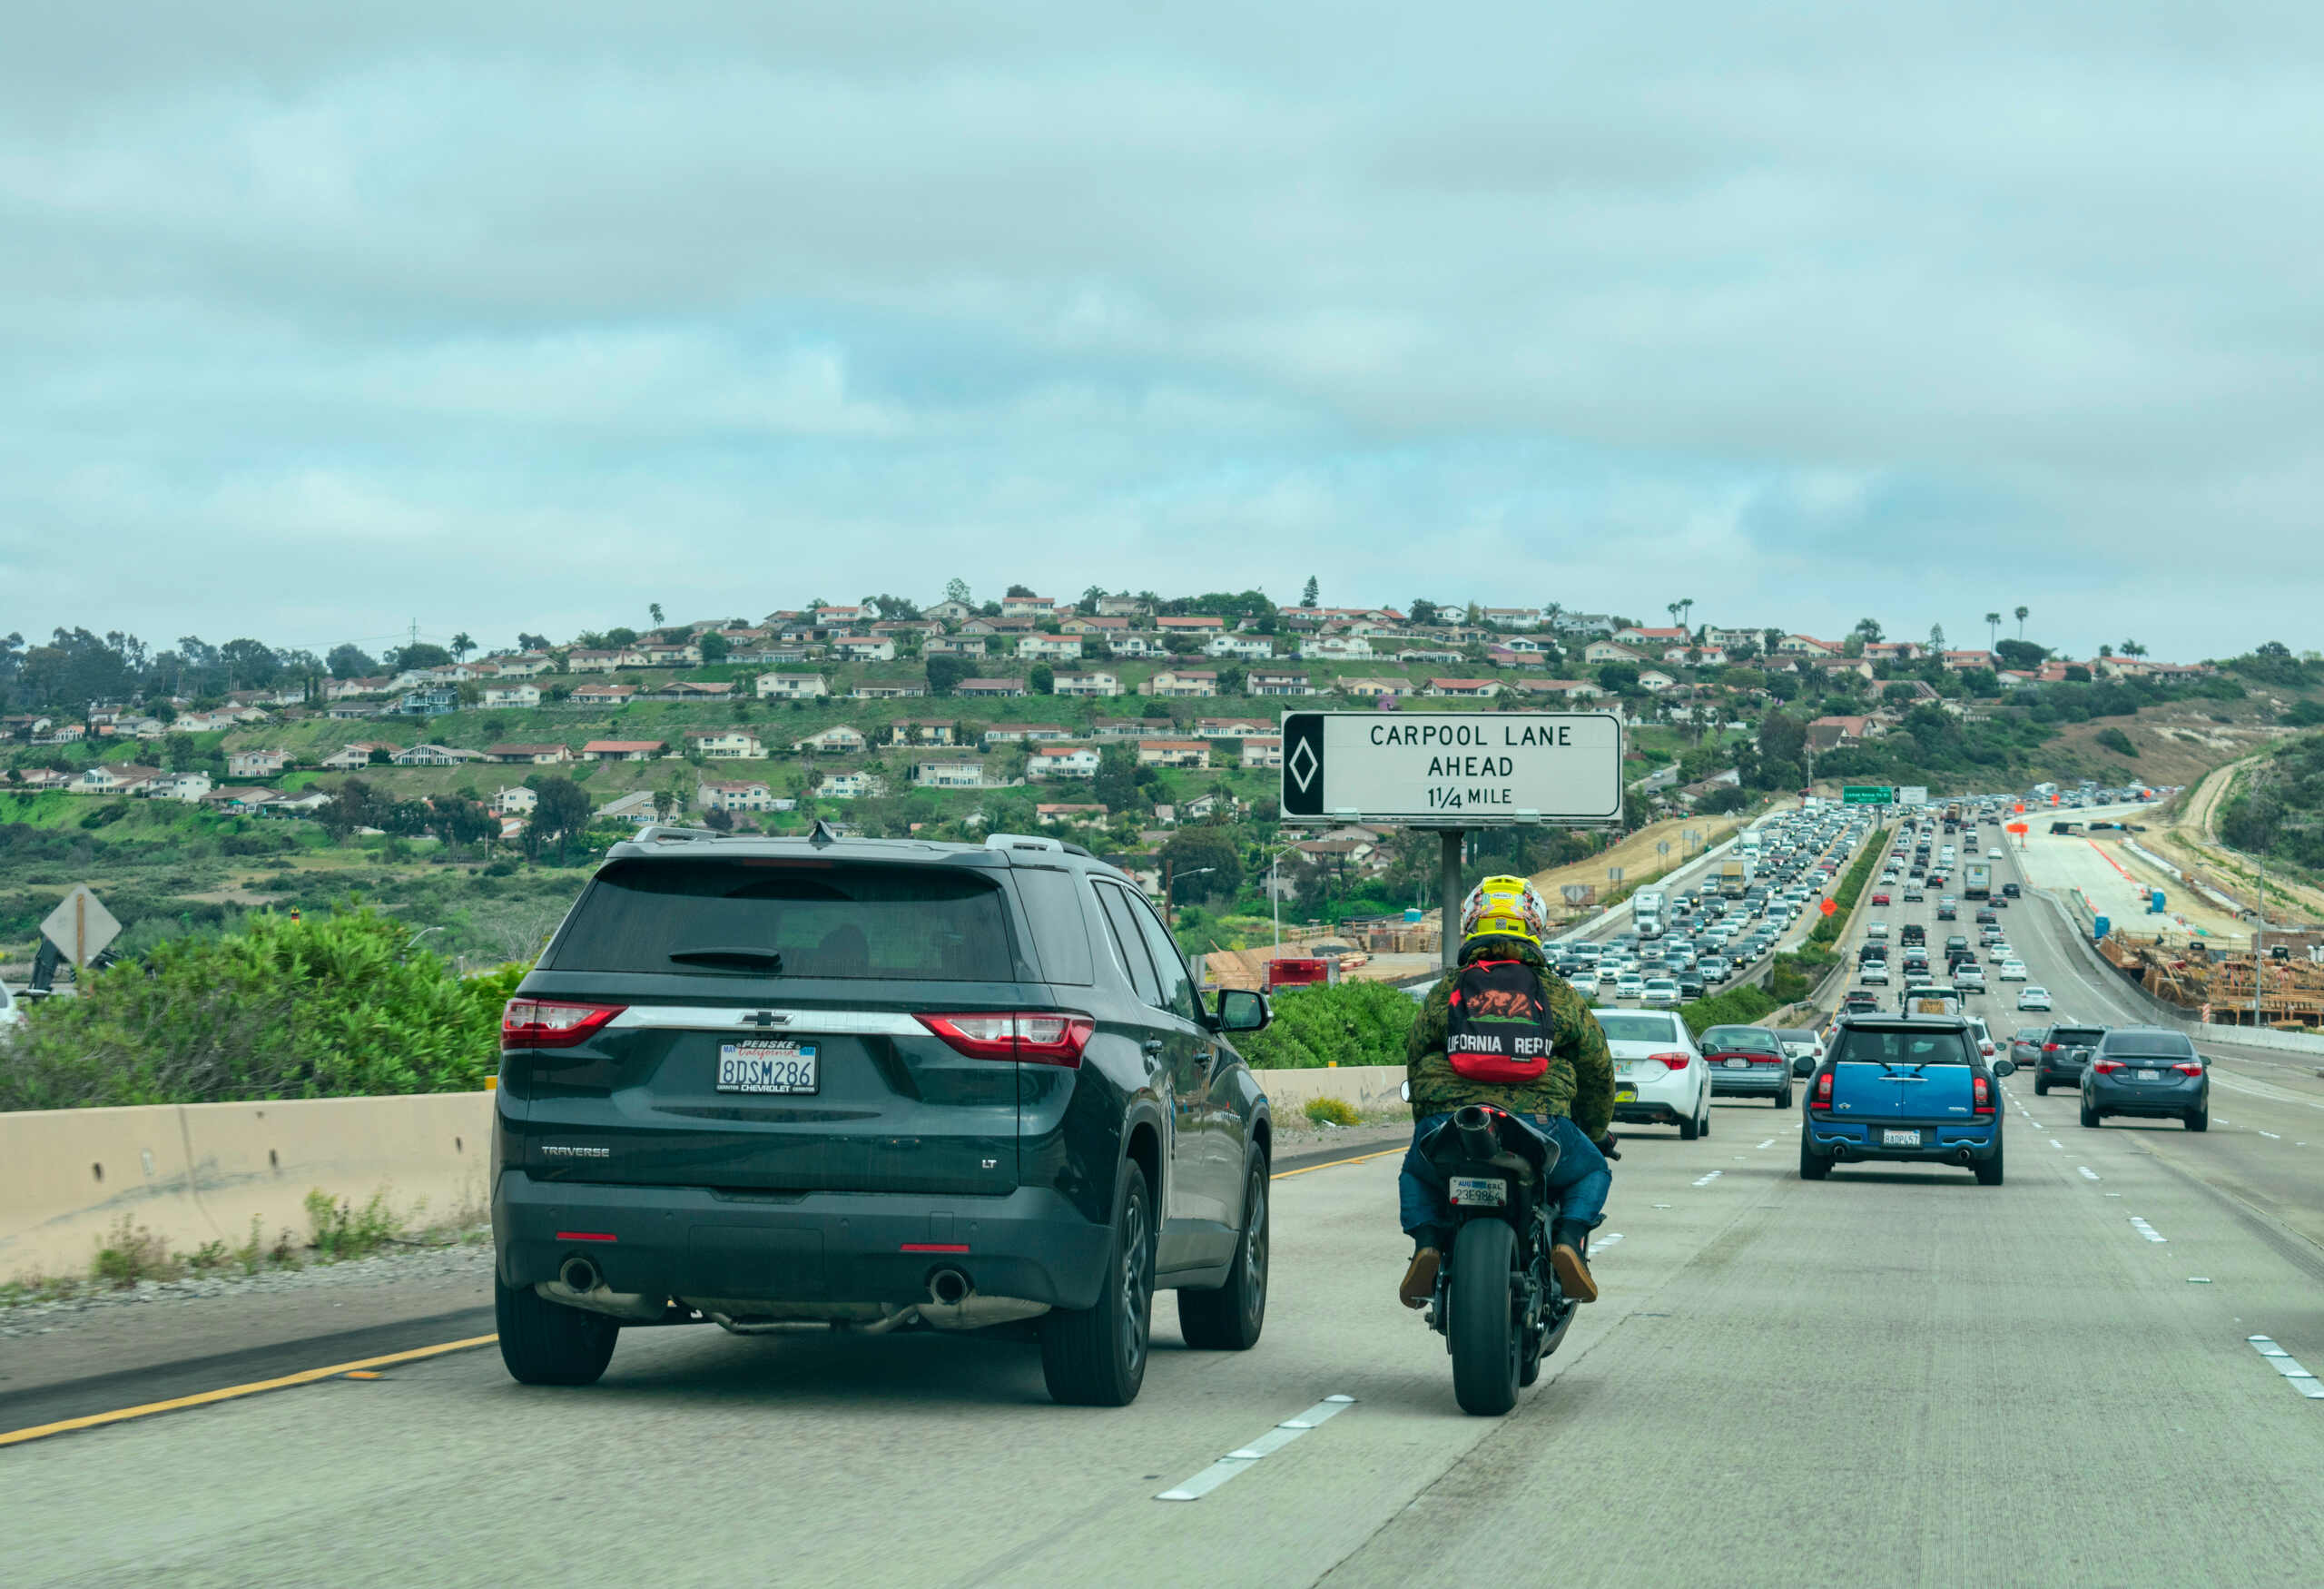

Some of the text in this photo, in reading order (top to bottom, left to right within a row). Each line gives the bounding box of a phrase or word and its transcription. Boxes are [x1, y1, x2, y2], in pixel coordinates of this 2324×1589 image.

[1370, 725, 1572, 746] CARPOOL LANE
[1427, 756, 1514, 777] AHEAD
[1468, 789, 1512, 804] MILE
[723, 1045, 736, 1053] MAY
[742, 1040, 796, 1049] PENSKE
[723, 1060, 812, 1086] 8DSM286
[741, 1084, 791, 1092] CHEVROLET
[541, 1146, 610, 1158] TRAVERSE
[981, 1160, 997, 1169] LT
